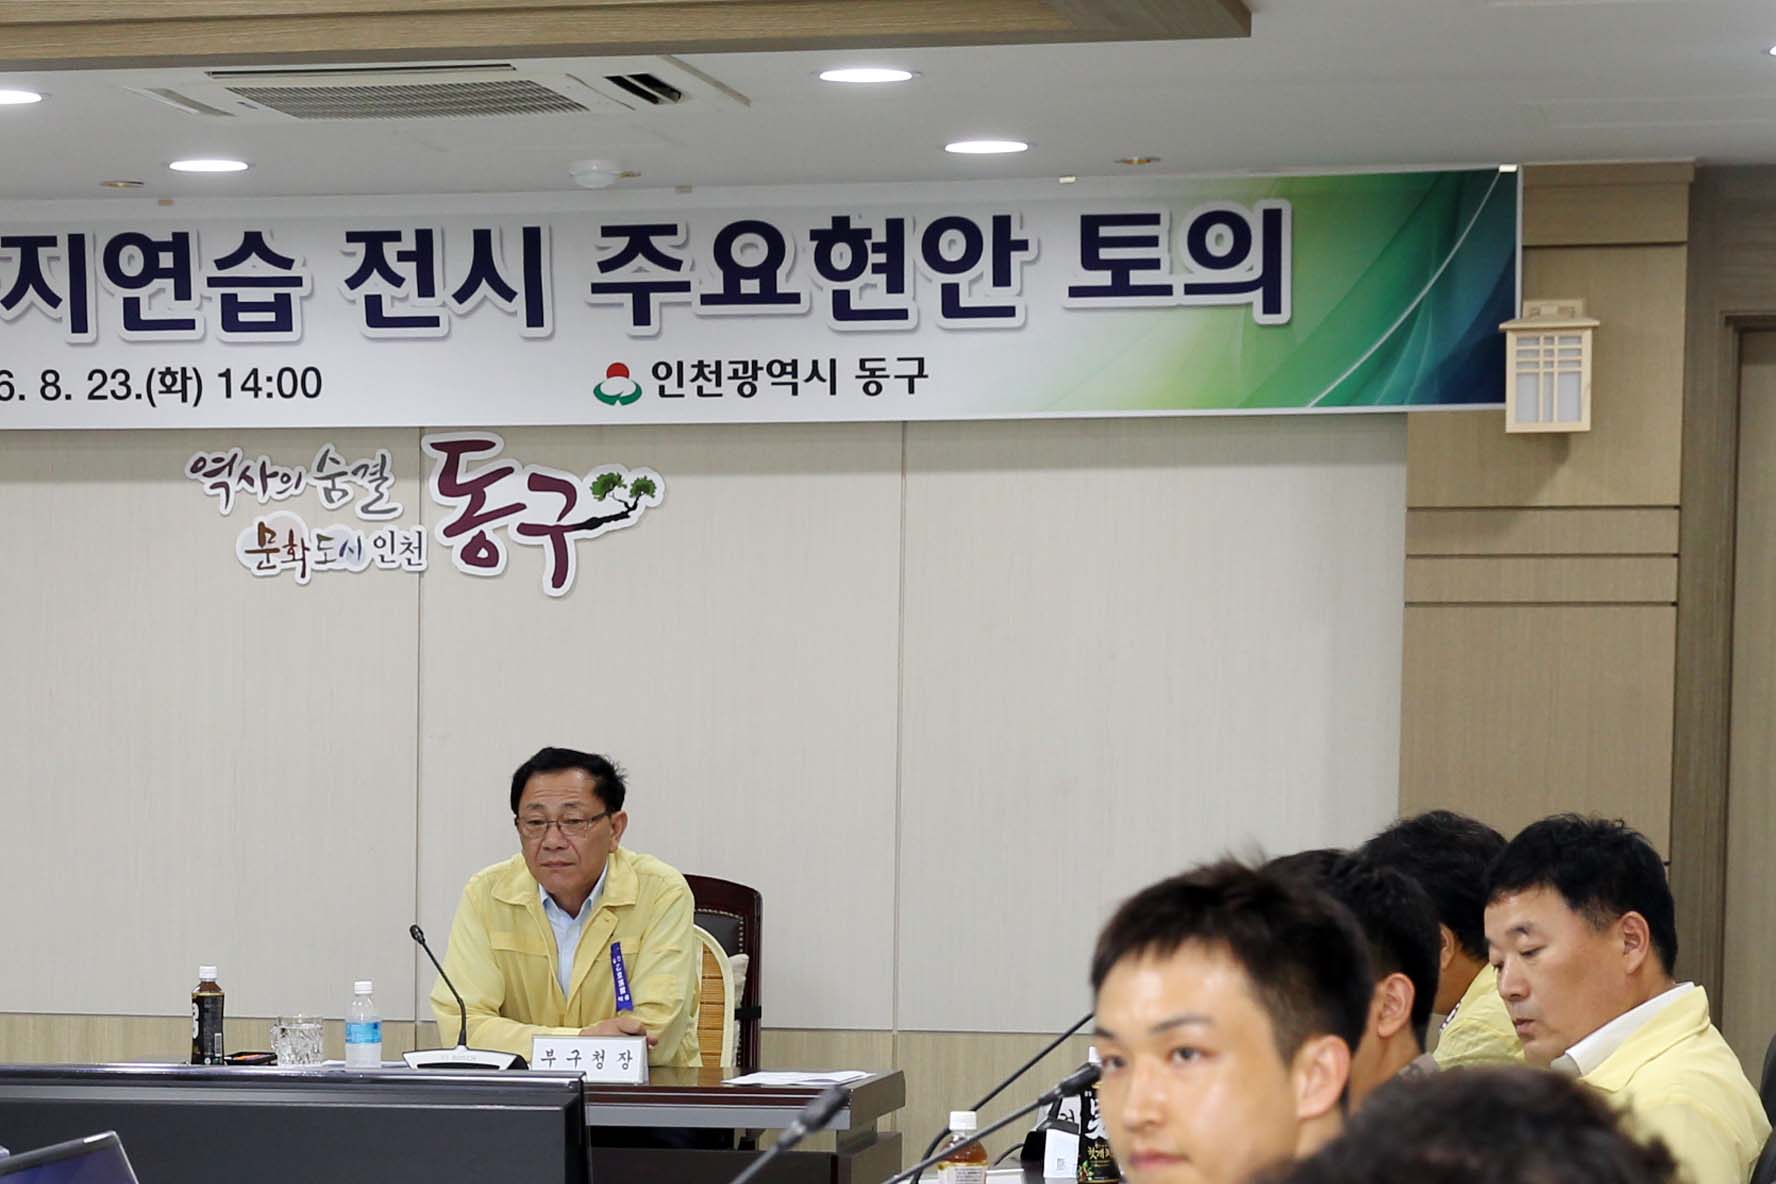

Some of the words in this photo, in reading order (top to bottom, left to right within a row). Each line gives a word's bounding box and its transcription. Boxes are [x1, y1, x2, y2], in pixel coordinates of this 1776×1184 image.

[342, 223, 548, 330] 전시
[589, 211, 1028, 328] 주요현안
[1065, 204, 1286, 318] 토의
[39, 370, 72, 402] 8.
[85, 366, 204, 408] 23.(화)
[216, 366, 323, 400] 14:00
[651, 358, 838, 399] 인천광역시
[854, 356, 929, 396] 동구
[189, 447, 304, 508] 역사의
[312, 443, 400, 516] 숨결
[423, 438, 580, 590] 동구
[244, 521, 364, 579] 문화도시
[372, 527, 423, 569] 인천
[540, 1048, 633, 1070] 부구청장
